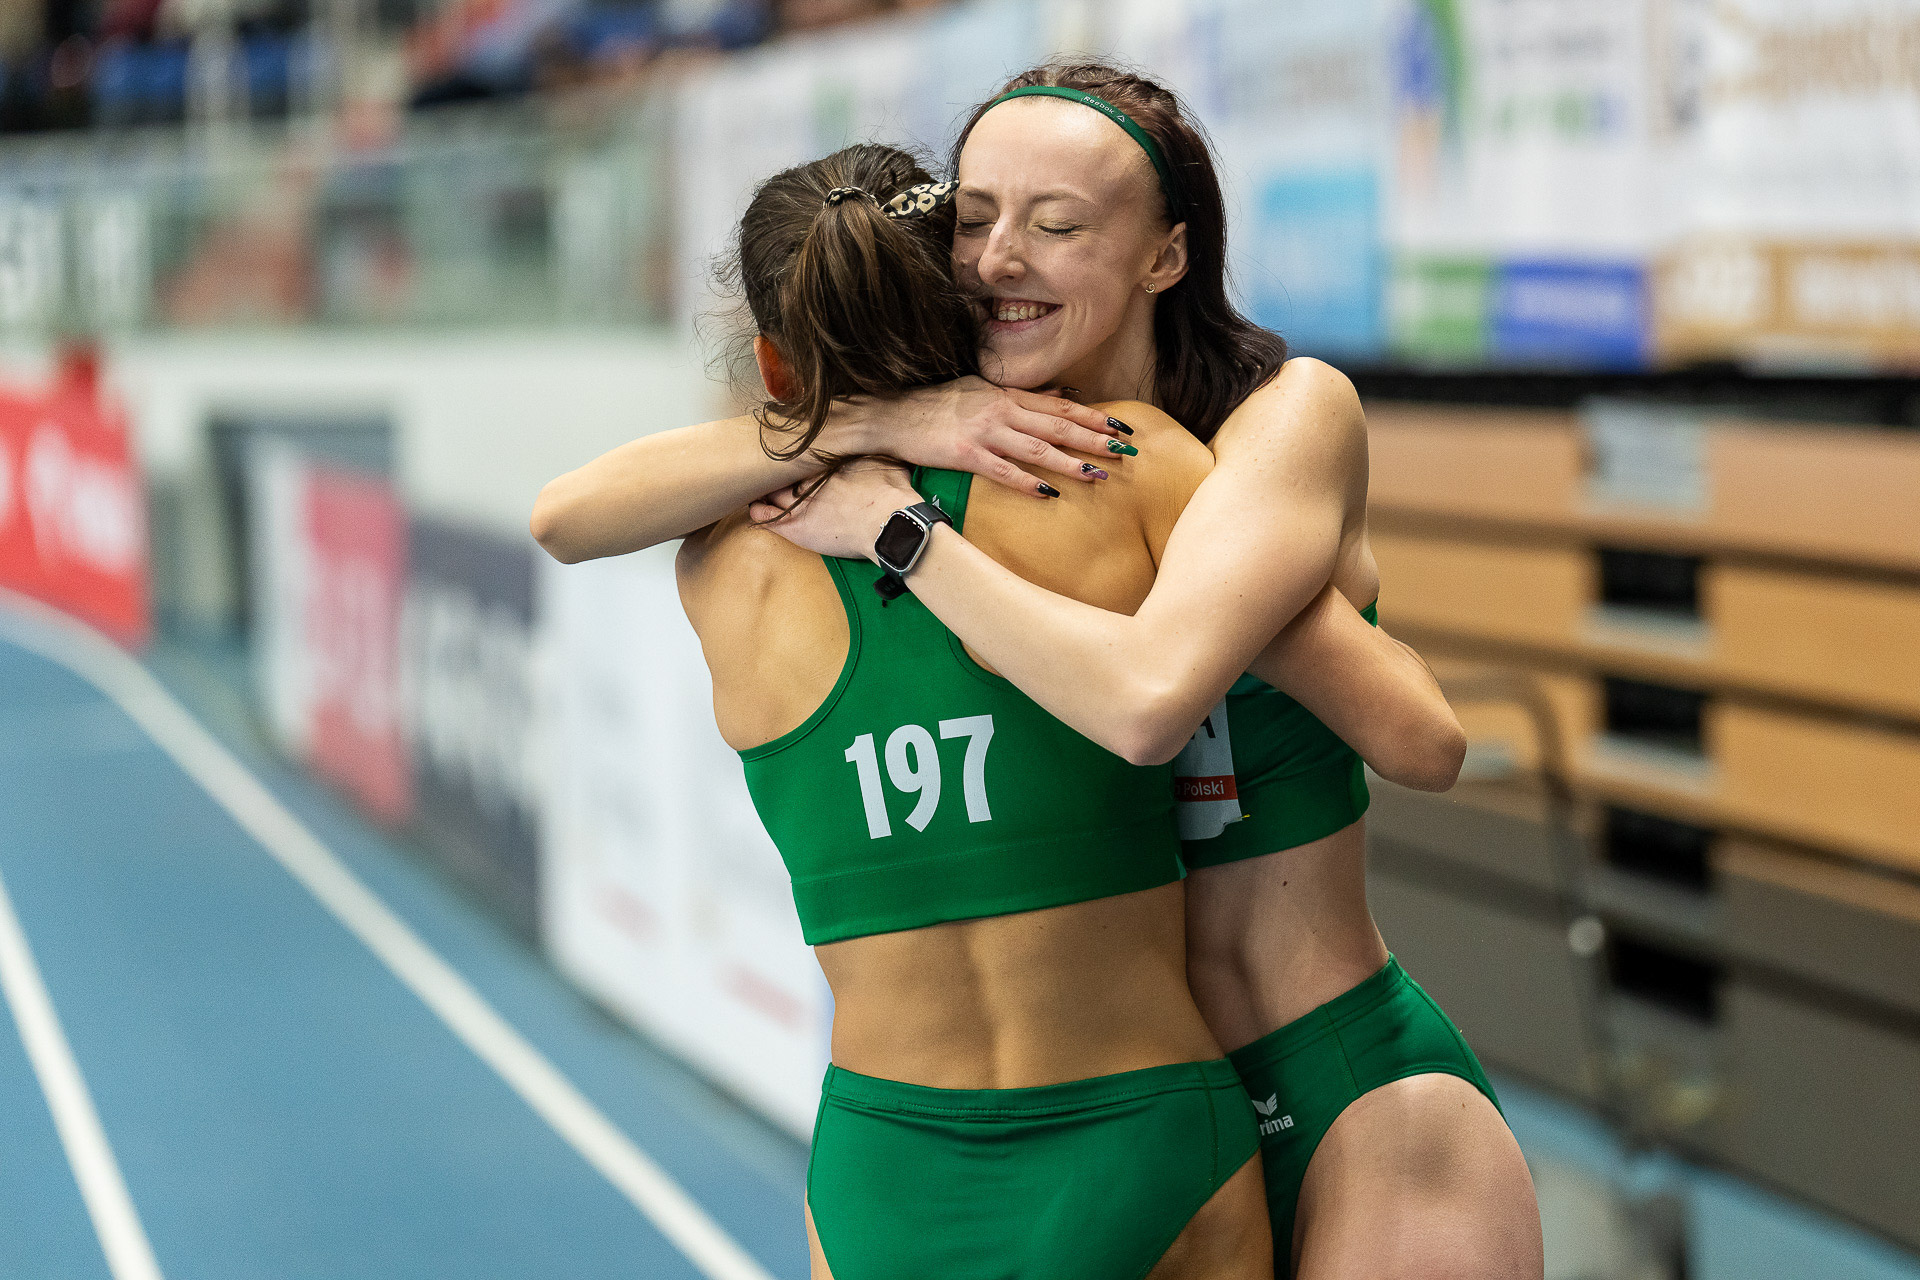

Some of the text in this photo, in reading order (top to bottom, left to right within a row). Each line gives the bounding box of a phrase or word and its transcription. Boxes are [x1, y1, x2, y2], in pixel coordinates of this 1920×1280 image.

[1083, 96, 1115, 115] Reebok
[844, 714, 995, 840] 197
[1183, 780, 1225, 797] Polski
[1259, 1114, 1295, 1137] rima
